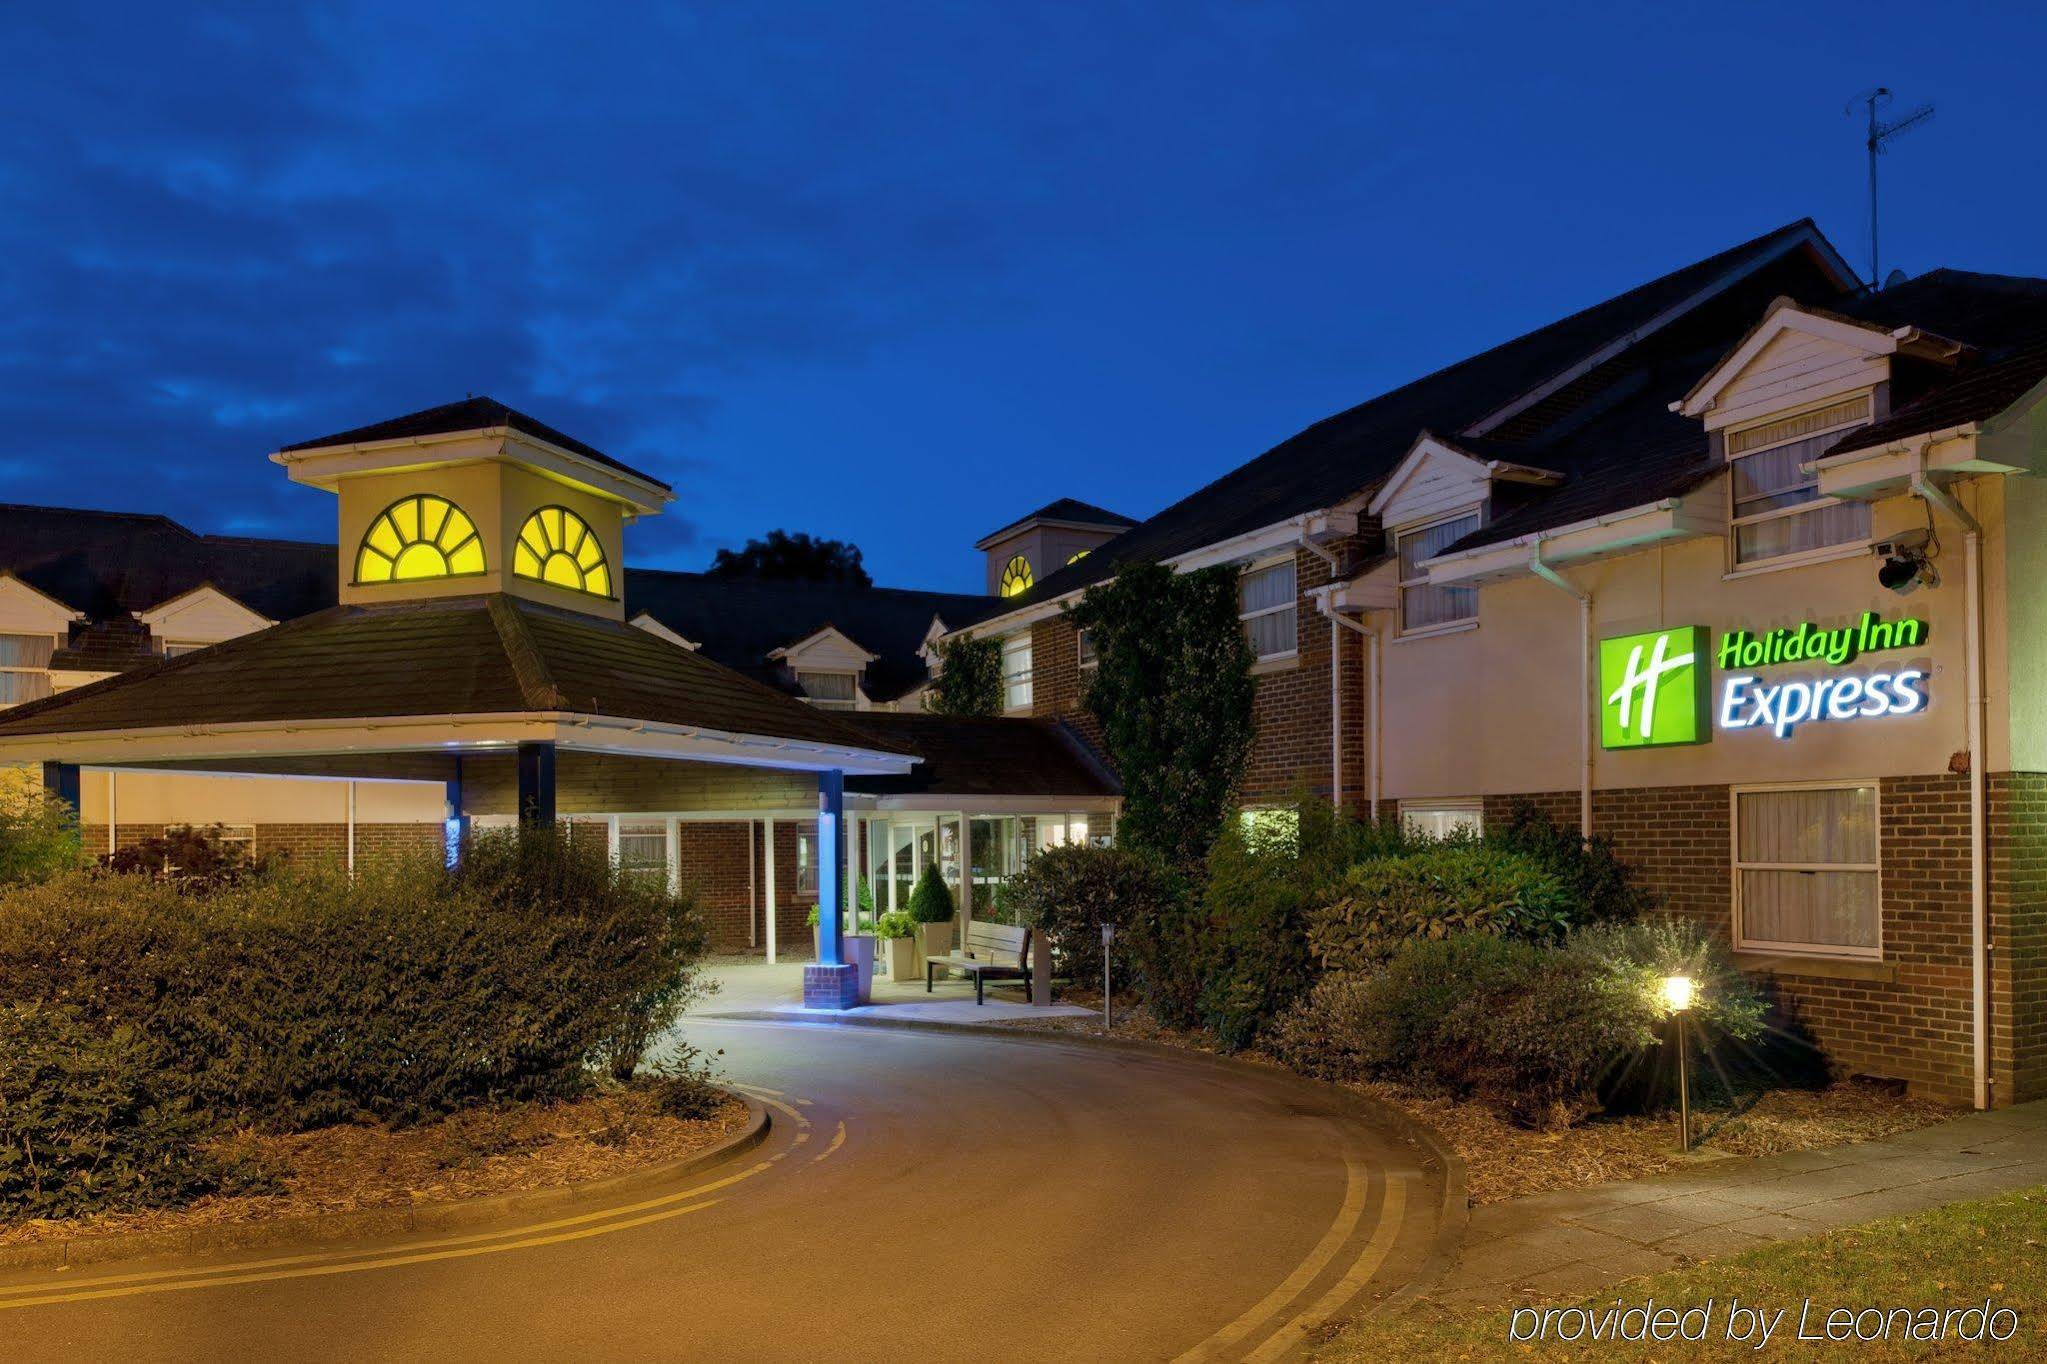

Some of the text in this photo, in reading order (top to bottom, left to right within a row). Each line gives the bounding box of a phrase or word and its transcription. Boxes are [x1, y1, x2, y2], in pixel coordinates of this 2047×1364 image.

[1717, 611, 1920, 668] Holiday Inn
[1719, 670, 1922, 738] Express
